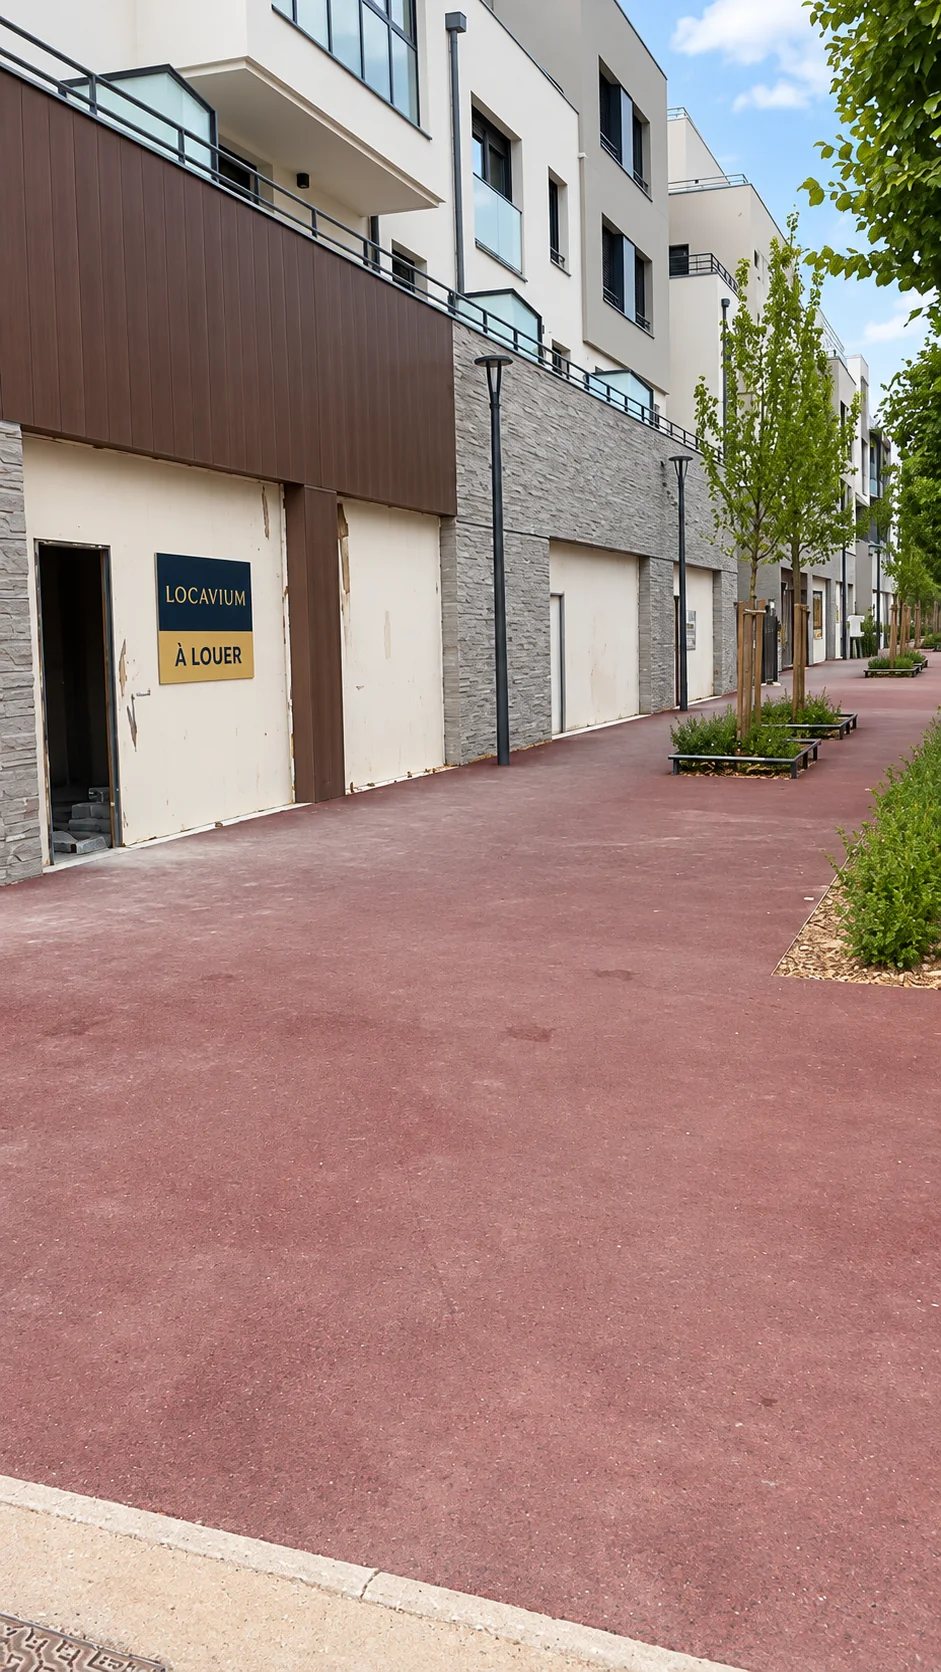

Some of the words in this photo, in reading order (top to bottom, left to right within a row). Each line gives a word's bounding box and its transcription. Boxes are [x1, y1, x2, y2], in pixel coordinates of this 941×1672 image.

[165, 585, 246, 606] LOCAVIUM
[175, 642, 187, 667] À
[191, 646, 242, 666] LOUER
